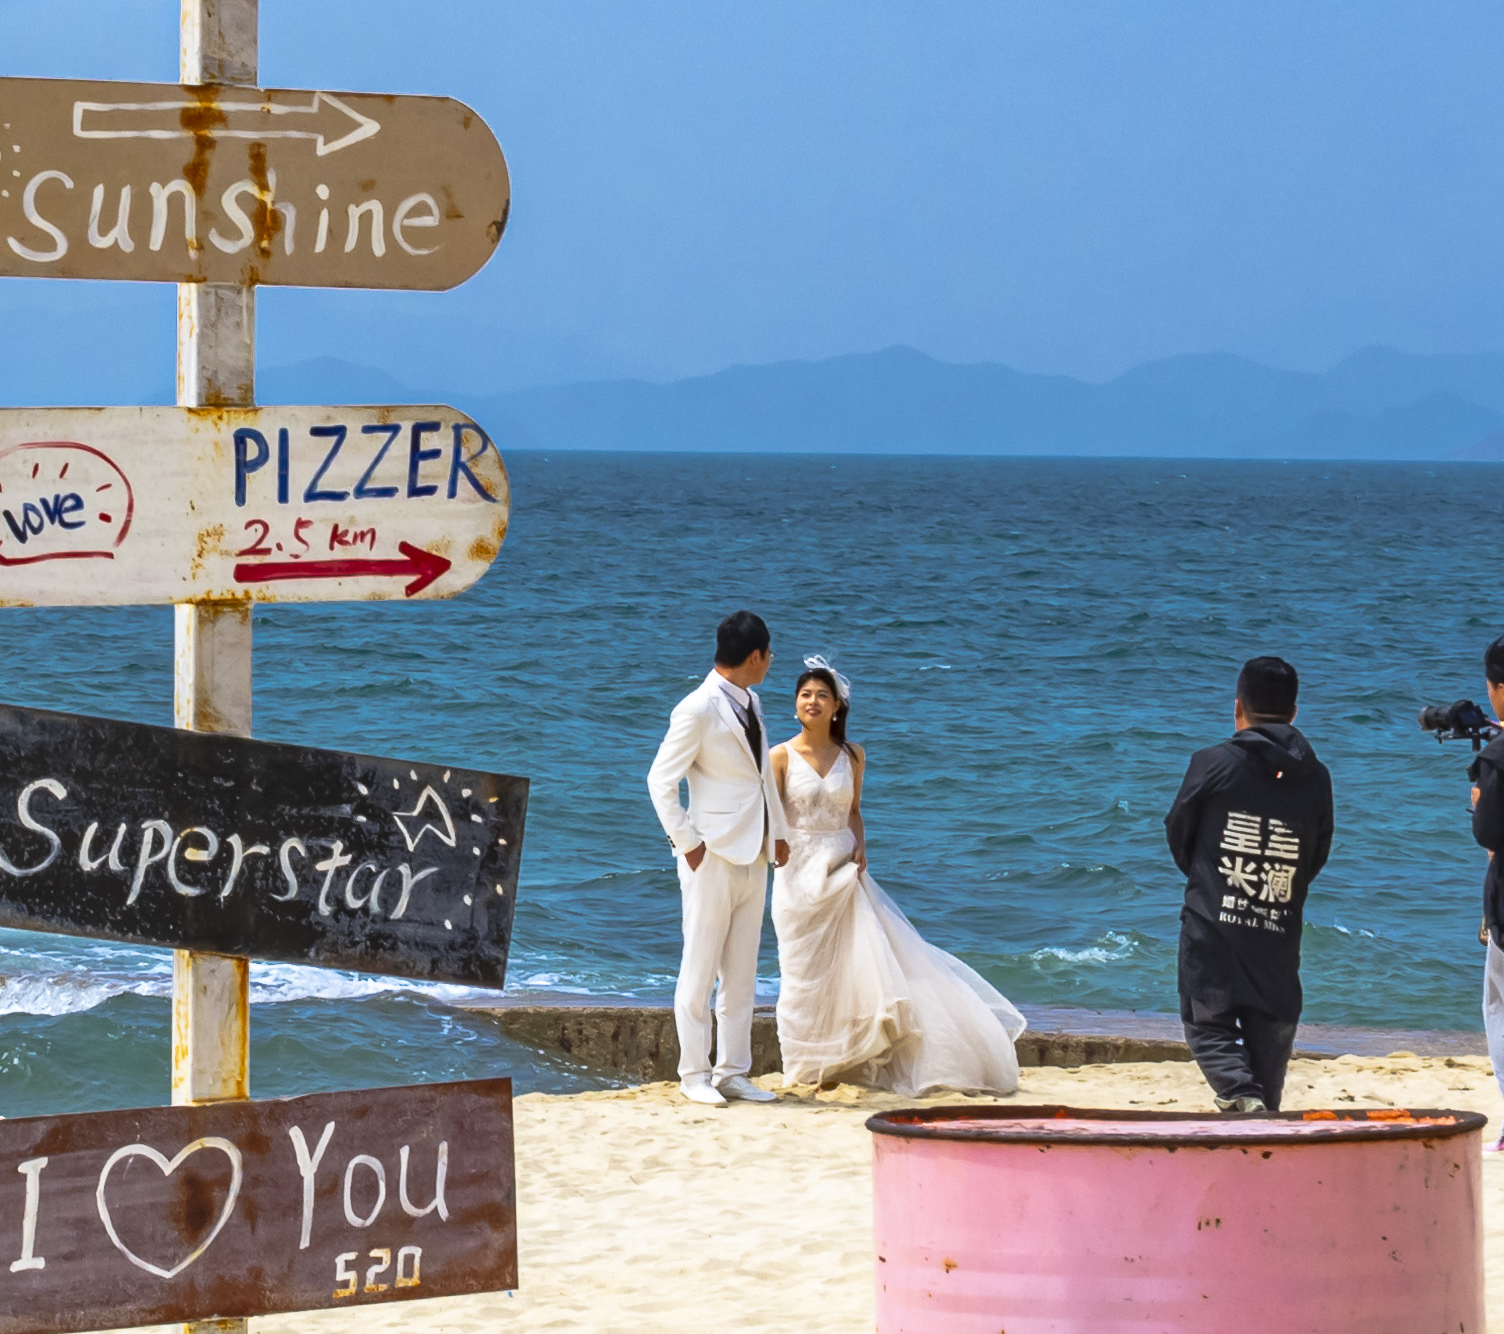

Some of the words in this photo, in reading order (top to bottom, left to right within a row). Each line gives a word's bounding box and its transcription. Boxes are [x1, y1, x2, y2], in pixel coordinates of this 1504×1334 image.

[6, 168, 443, 263] Sunshine
[233, 420, 499, 507] PIZZER
[9, 1156, 49, 1273] I
[333, 1245, 423, 1299] 520
